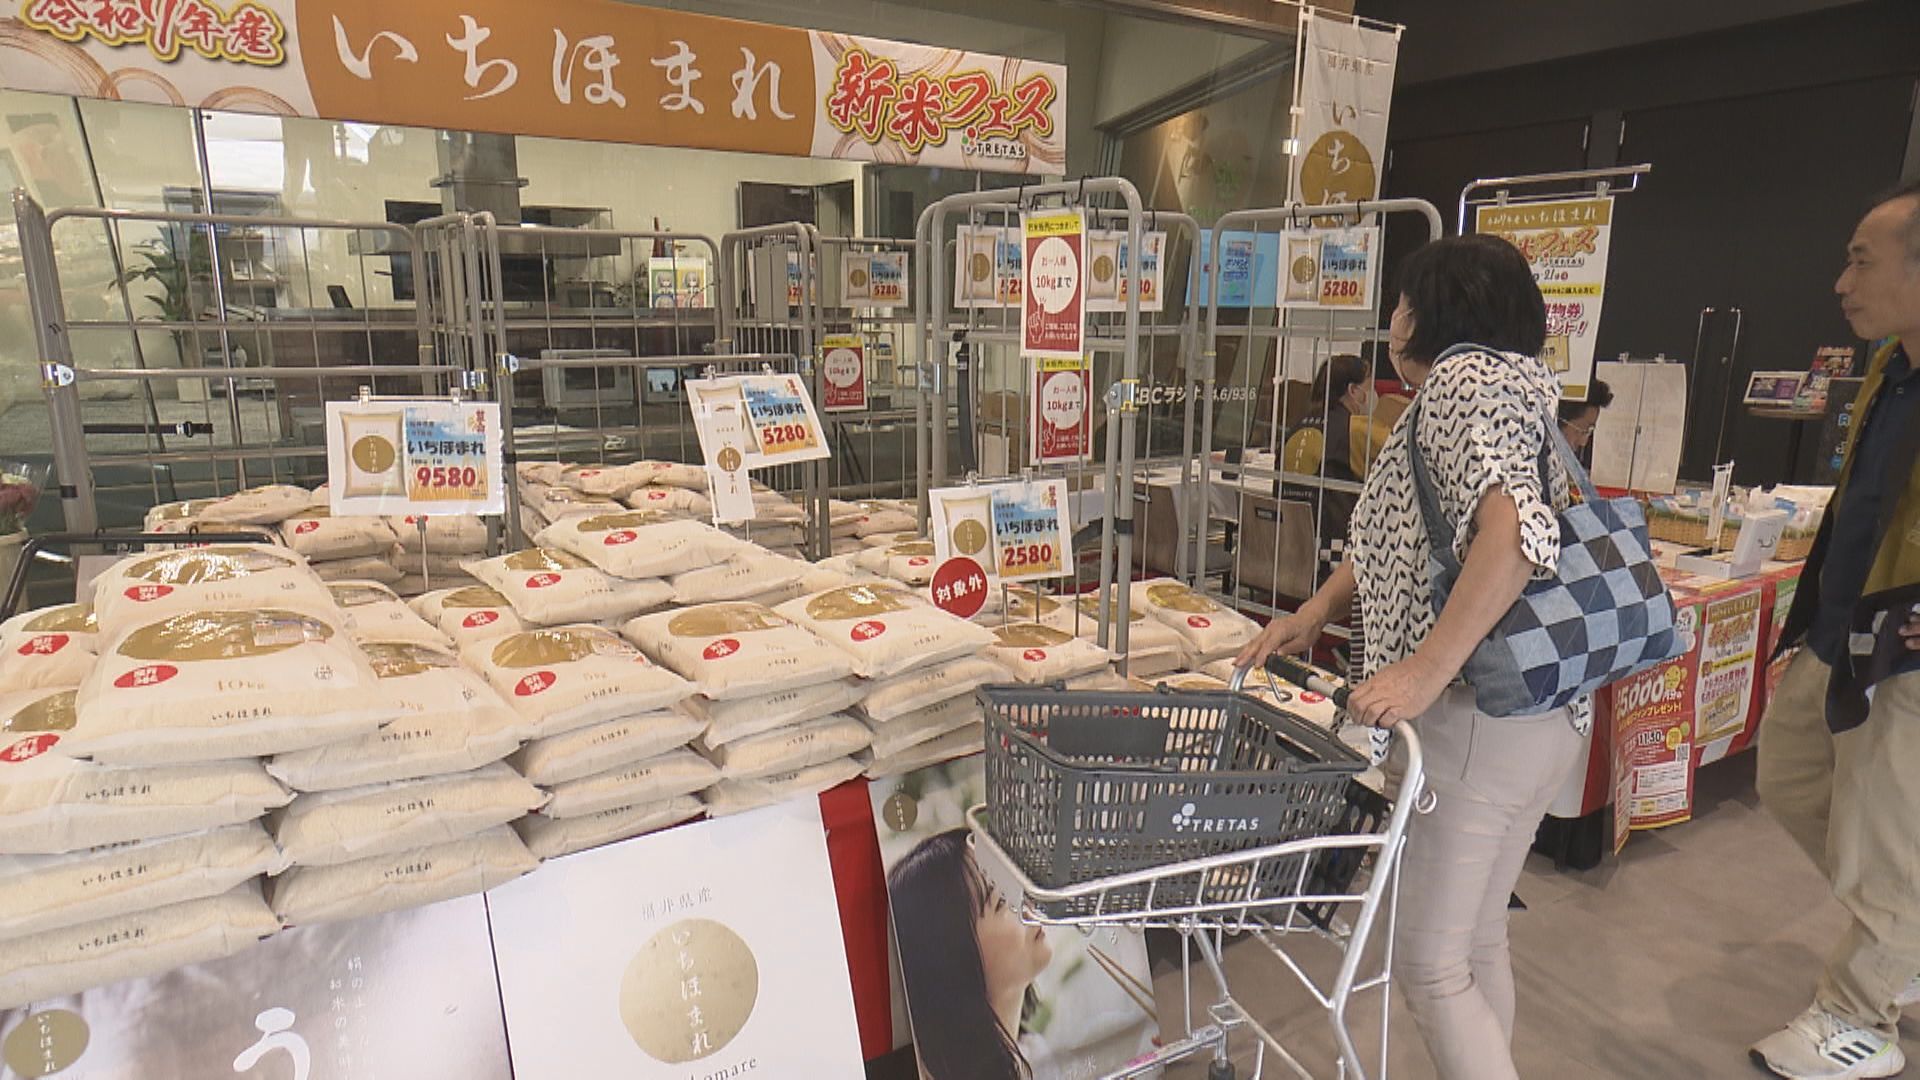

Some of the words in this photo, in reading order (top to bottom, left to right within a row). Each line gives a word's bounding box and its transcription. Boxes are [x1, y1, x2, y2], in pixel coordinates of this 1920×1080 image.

[332, 14, 796, 120] いちほまれ
[829, 51, 1053, 148] 新米フェス
[977, 142, 1025, 157] TRETAS
[1036, 275, 1072, 290] 10kgまで
[1323, 280, 1358, 297] 5280
[751, 402, 806, 418] いちほまれ
[763, 424, 805, 445] 5280
[408, 440, 486, 455] いちほまれ
[416, 466, 476, 488] 9580
[996, 517, 1059, 536] いちほまれ
[1004, 543, 1052, 568] 2580
[936, 573, 983, 604] 対象外
[211, 708, 272, 720] いちほまれ
[85, 784, 151, 800] いちほまれ
[1192, 817, 1259, 833] TRETAS
[82, 864, 147, 886] いちほまれ
[78, 928, 145, 951] いちほまれ
[672, 930, 712, 1055] いちほまれ
[37, 1014, 57, 1073] いちほまれ
